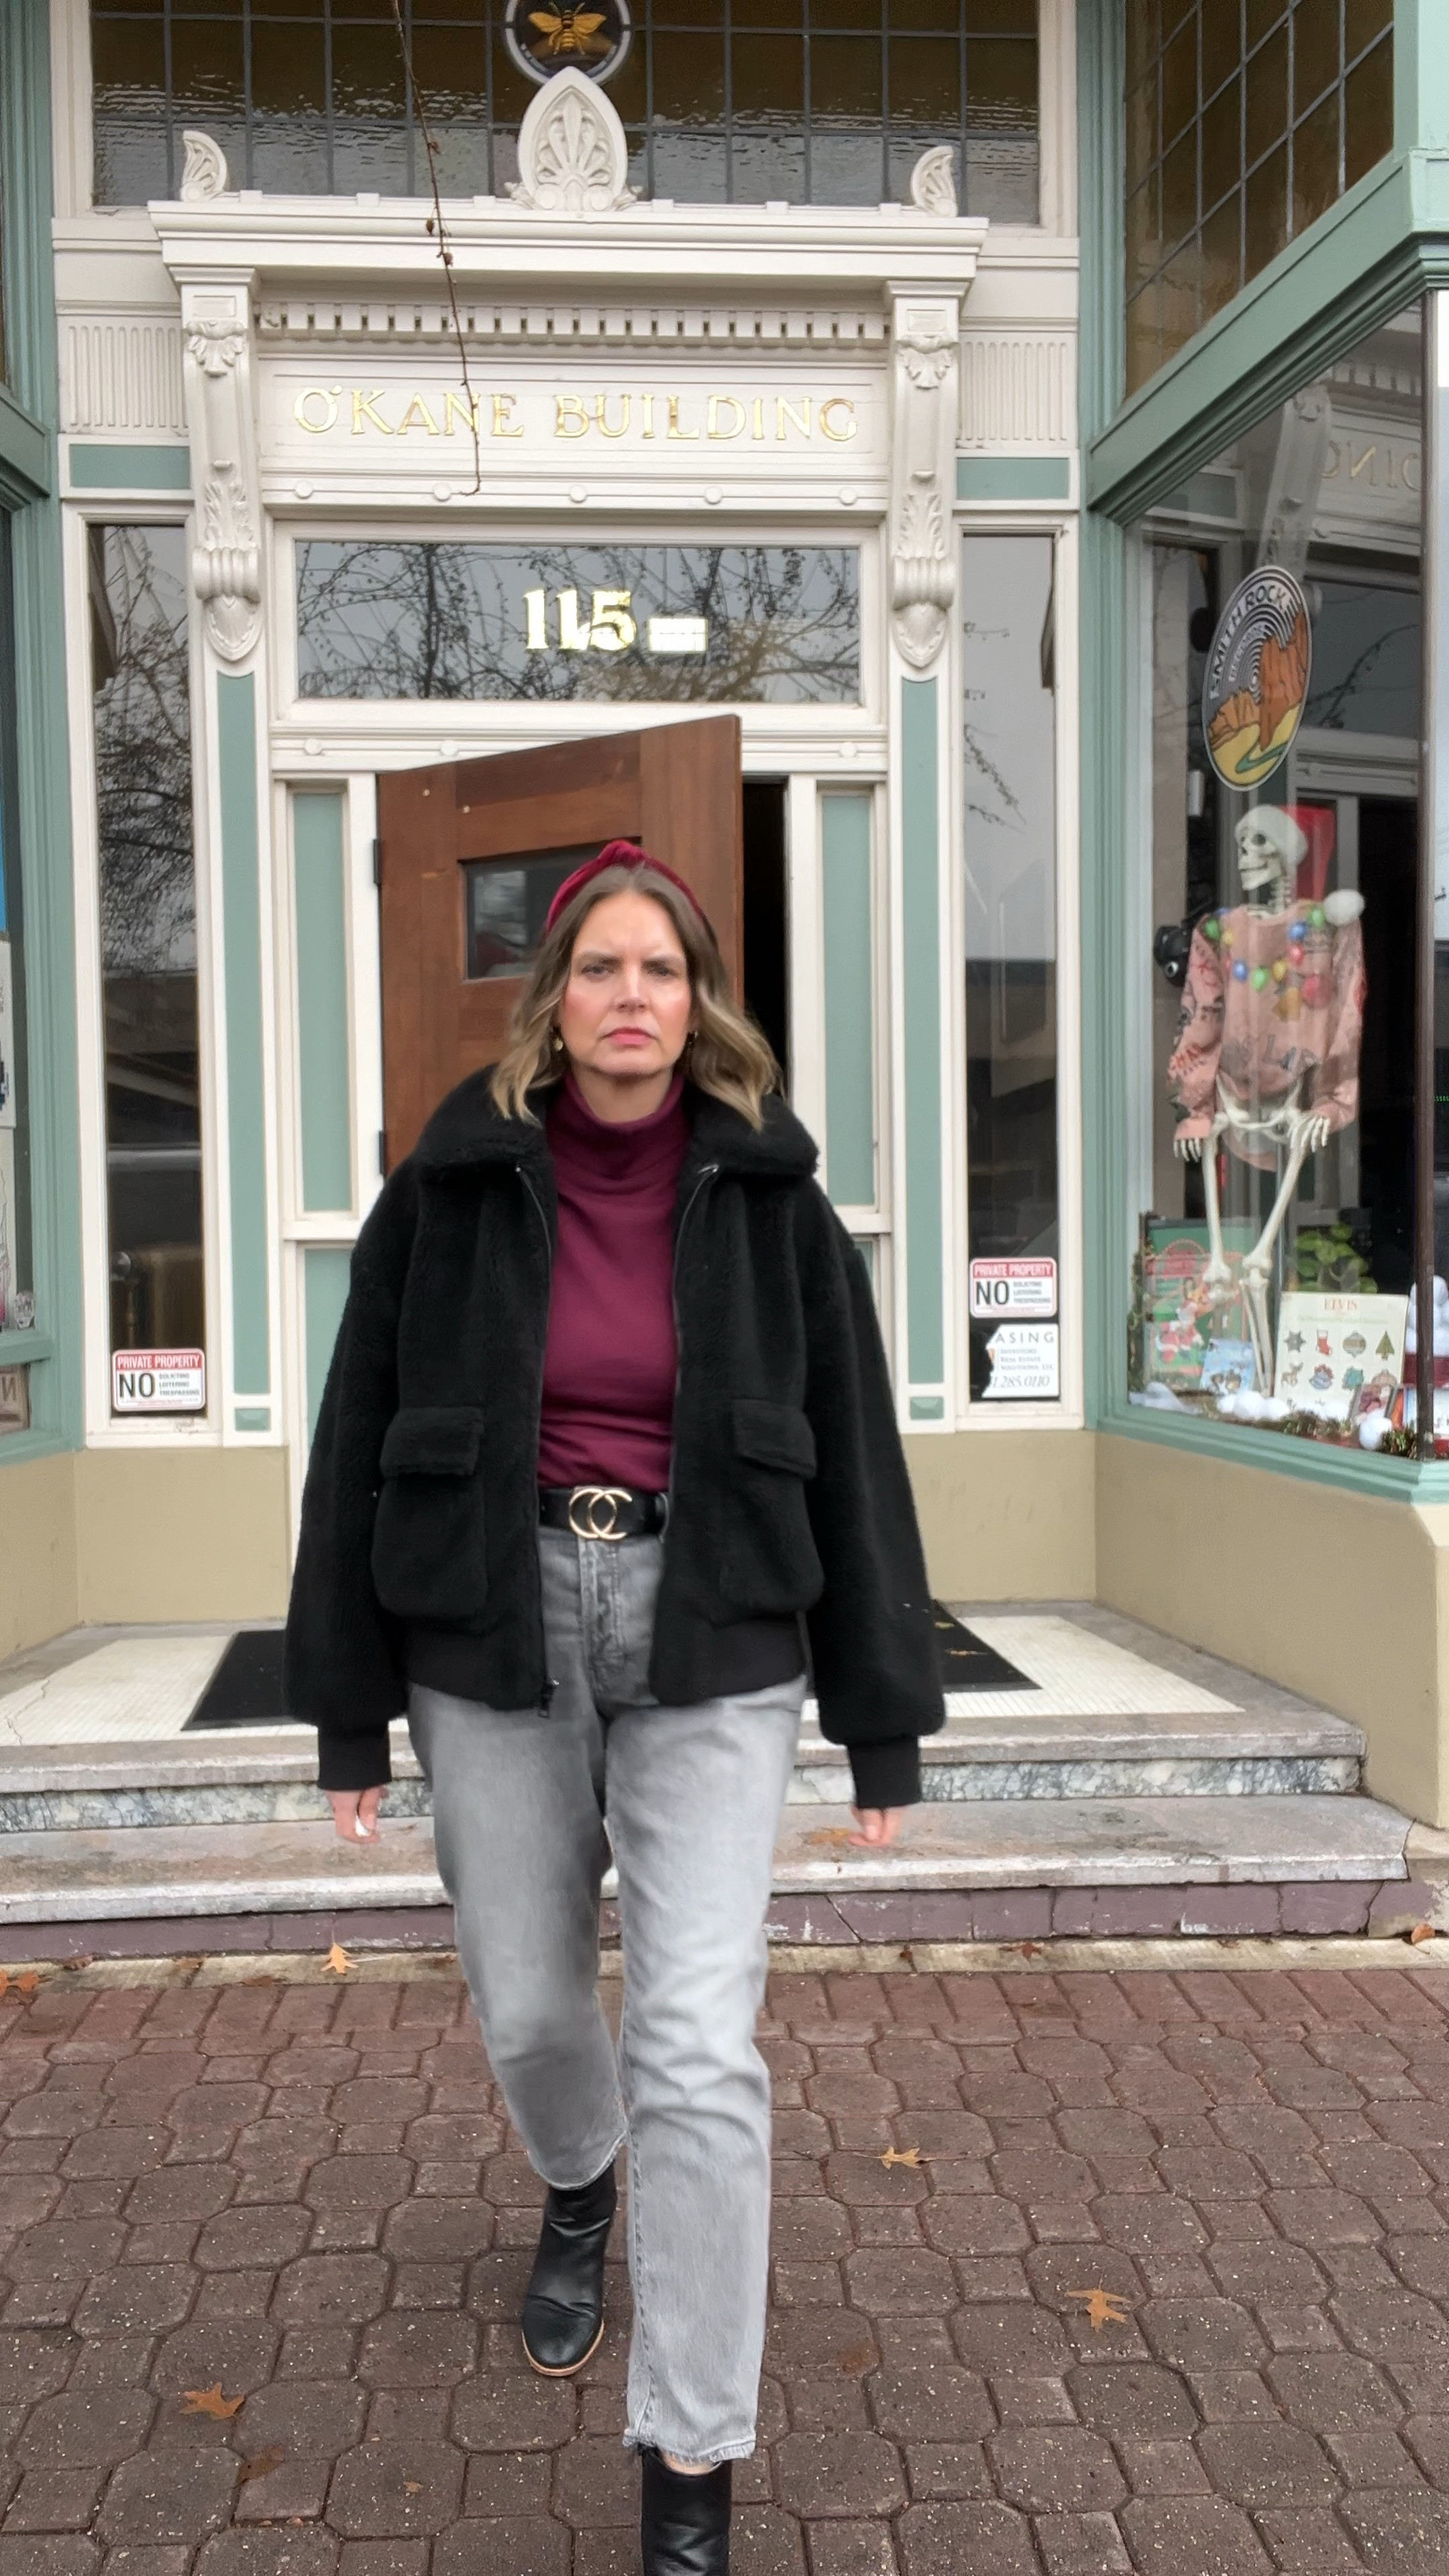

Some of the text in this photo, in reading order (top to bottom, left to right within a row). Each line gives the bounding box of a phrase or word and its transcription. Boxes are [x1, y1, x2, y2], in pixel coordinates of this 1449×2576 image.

[293, 385, 859, 441] O'KANE BUILDING
[1245, 585, 1286, 611] ROCK
[523, 588, 637, 651] 115
[975, 1263, 1052, 1277] PRIVATE PROPERTY
[976, 1280, 1010, 1305] NO
[118, 1354, 200, 1369] PRIVATE PROPERTY
[119, 1373, 155, 1398] NO
